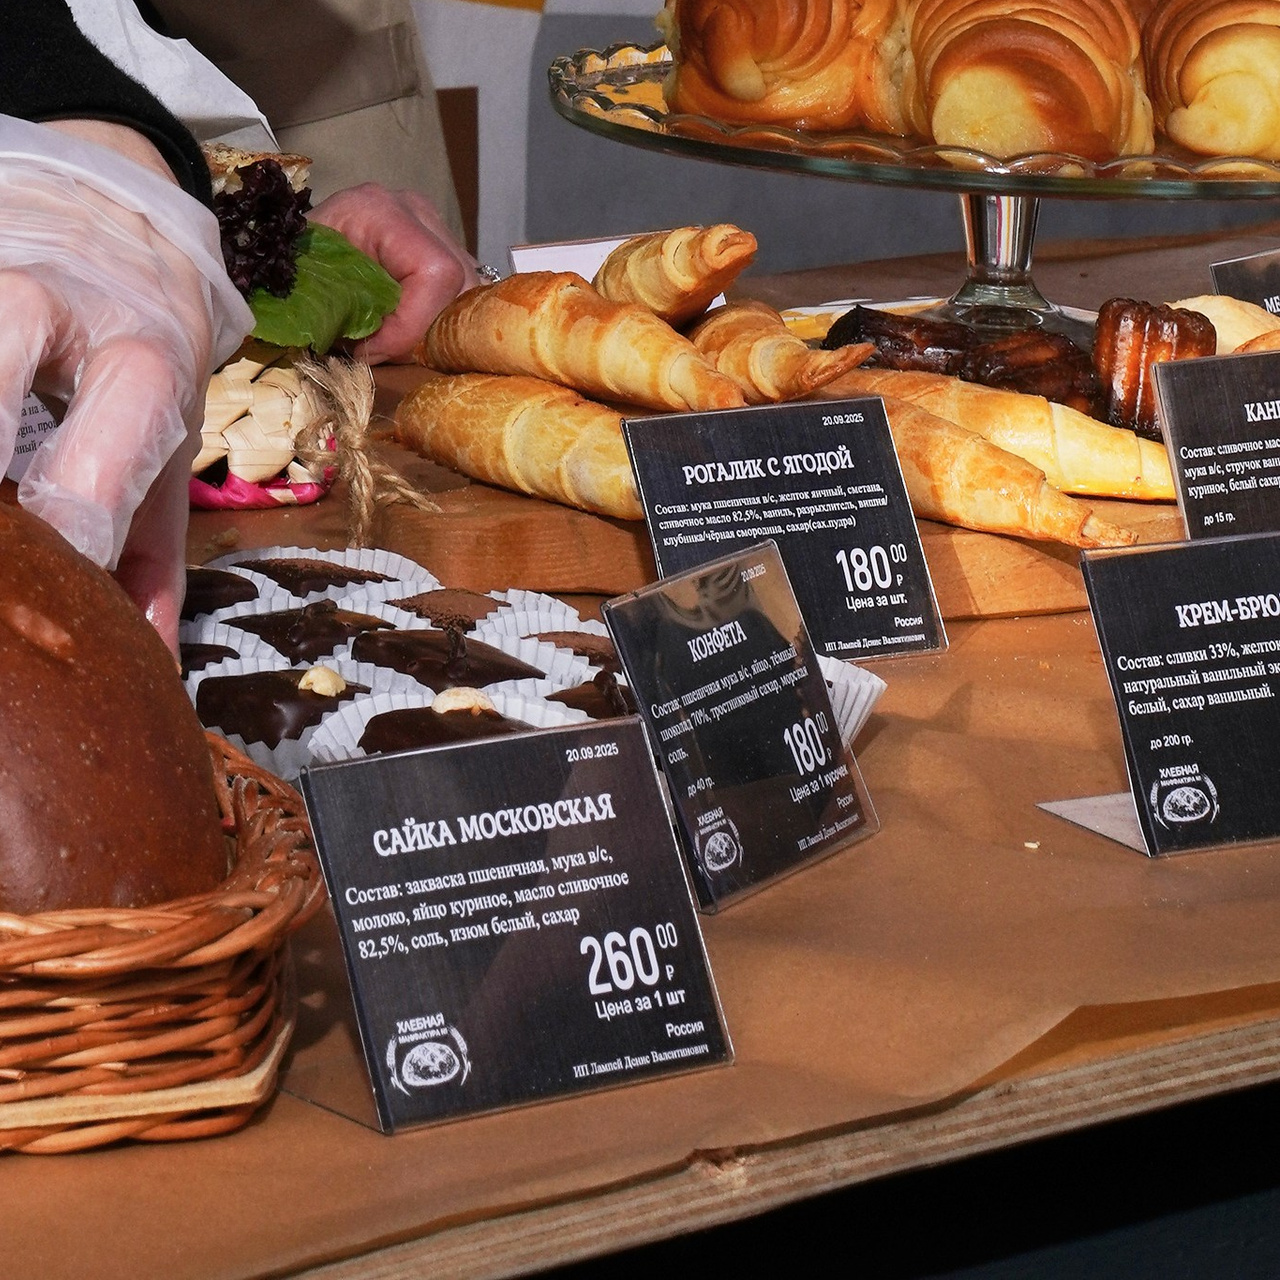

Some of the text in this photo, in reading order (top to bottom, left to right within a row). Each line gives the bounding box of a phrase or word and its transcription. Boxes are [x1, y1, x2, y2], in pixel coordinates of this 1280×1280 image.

[17, 423, 36, 438] gin,
[822, 413, 864, 427] 20.09.2025
[1180, 446, 1216, 459] Состав:
[1217, 440, 1263, 455] сливочное
[682, 444, 854, 485] РОГАЛИК С ЯГОДОЙ
[1184, 466, 1207, 481] мука
[1209, 462, 1225, 476] в/с,
[1225, 459, 1262, 475] стручок
[655, 482, 883, 515] Состав: мука пшеничная в/с, желток яичный, сметана,
[1188, 483, 1228, 500] куриное,
[1229, 476, 1257, 491] белый
[658, 517, 704, 530] сливочное
[706, 514, 731, 526] масло
[732, 509, 762, 523] 82,5%,
[763, 507, 796, 519] ваниль,
[797, 501, 858, 517] разрыхлитель,
[1204, 512, 1236, 526] до 15 гр.
[736, 524, 785, 538] смородина,
[835, 543, 907, 592] 180 00
[846, 593, 908, 612] Цена за шт.
[1175, 592, 1280, 628] КРЕМ-БРЮ
[894, 616, 923, 627] Россия
[686, 621, 747, 663] КОНФЕТА
[1117, 653, 1164, 671] Состав:
[1166, 649, 1208, 665] сливки
[1208, 642, 1240, 659] 33%,
[651, 698, 682, 719] Состав:
[720, 673, 739, 691] мука
[739, 665, 752, 681] в/с,
[1123, 661, 1266, 694] натуральный ванильный
[660, 718, 694, 741] шоколад
[691, 707, 712, 727] 70%,
[758, 678, 782, 697] сахар,
[1129, 683, 1275, 716] белый, сахар ванильный.
[566, 742, 619, 762] 20.09.2025
[668, 746, 689, 764] соль.
[783, 711, 829, 776] 180 00
[1150, 734, 1194, 750] до 200 гр.
[789, 764, 849, 804] Цена за 1 кусочек
[1159, 763, 1199, 779] ХЛЕБНАЯ
[688, 776, 715, 798] до 40 гр.
[373, 793, 616, 857] САЙКА МОСКОВСКАЯ
[697, 806, 725, 827] ХЛЕБНАЯ
[345, 845, 613, 906] Состав: закваска пшеничная, мука в/с,
[352, 871, 629, 933] молоко, яйцо куриное, масло сливочное
[358, 906, 580, 960] 82,5%, соль, изюм белый, сахар
[580, 922, 678, 995] 260 00
[594, 989, 686, 1021] Цена за 1 шт
[396, 1012, 445, 1034] ХЛЕБНАЯ
[666, 1021, 704, 1038] Россия
[573, 1062, 589, 1078] ИП
[624, 1054, 650, 1070] Денис
[650, 1044, 709, 1063] Валентинович
